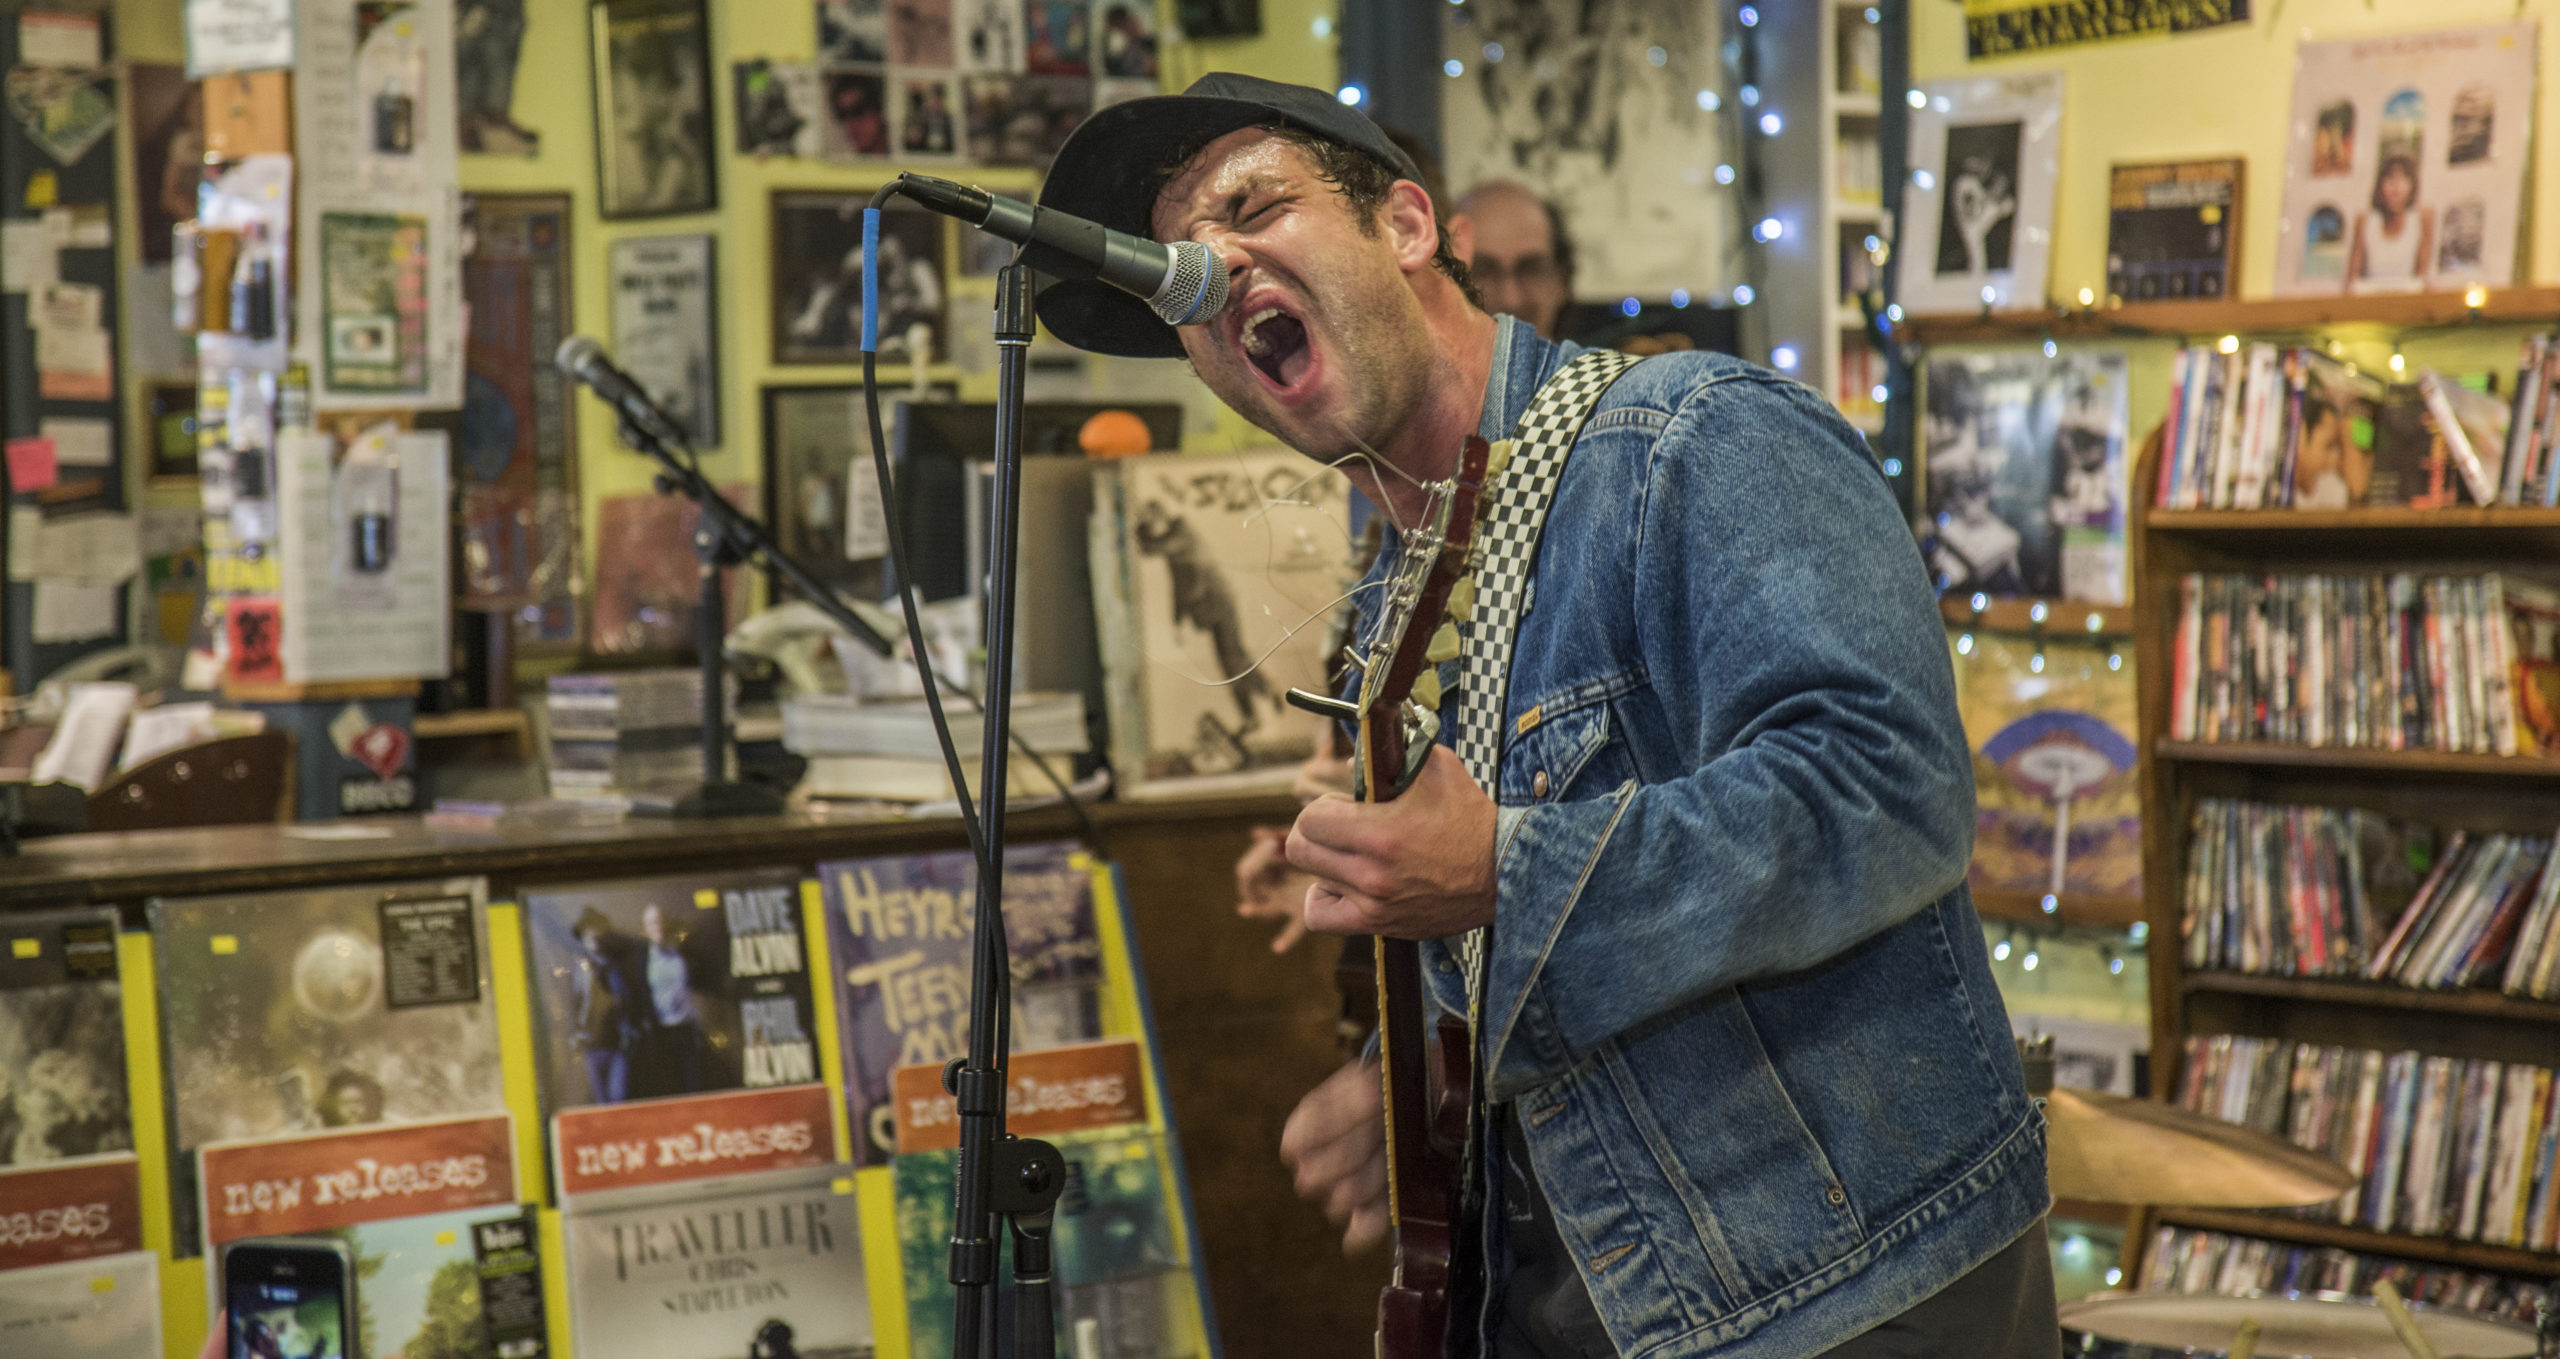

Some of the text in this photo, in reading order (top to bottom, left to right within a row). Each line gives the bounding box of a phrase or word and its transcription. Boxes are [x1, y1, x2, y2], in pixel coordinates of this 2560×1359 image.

[723, 886, 796, 934] DAVE
[731, 932, 802, 978] ALVIN
[741, 998, 807, 1047] PHIL
[743, 1041, 815, 1087] ALVIN
[575, 1122, 813, 1176] new releases
[222, 1155, 489, 1217] new releases
